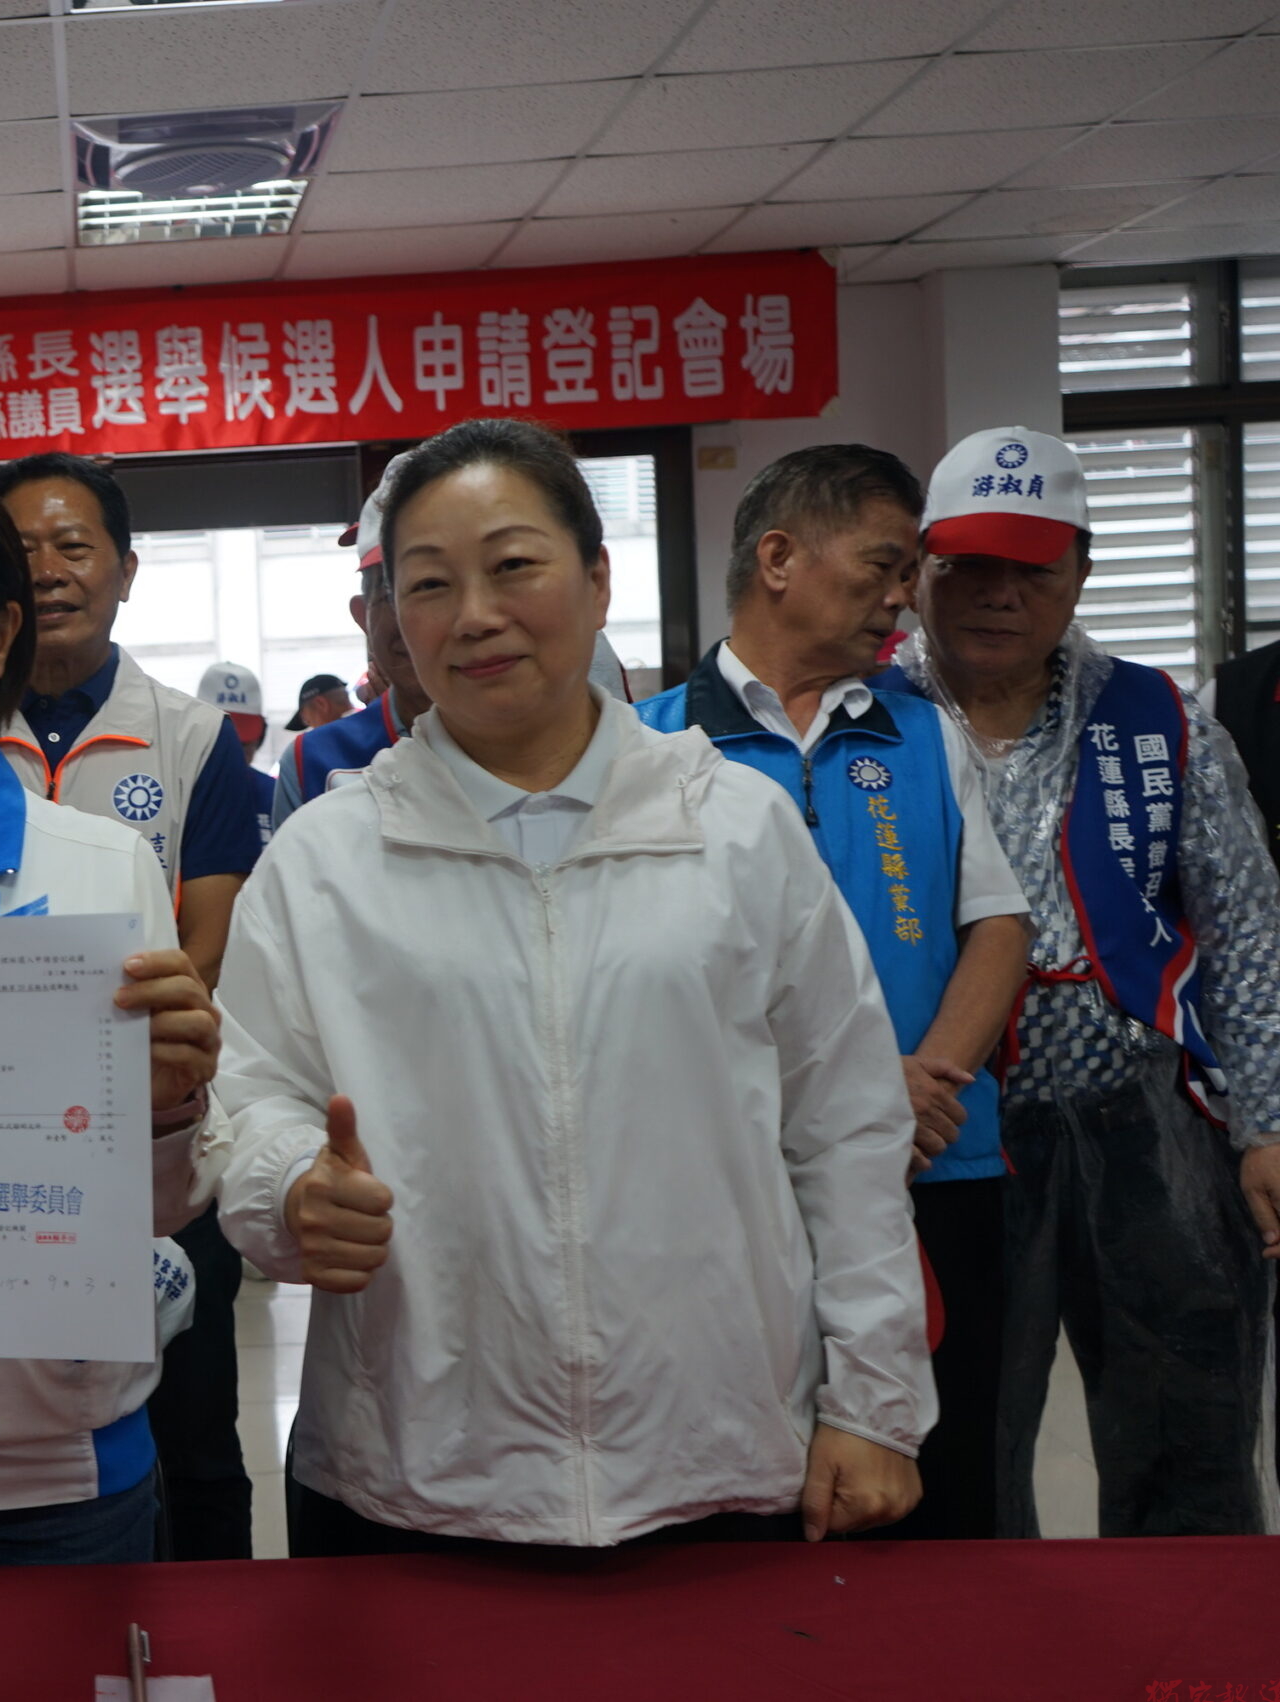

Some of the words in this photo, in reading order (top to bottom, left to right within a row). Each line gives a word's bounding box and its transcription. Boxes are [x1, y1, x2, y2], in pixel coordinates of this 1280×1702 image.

[89, 293, 794, 426] 選舉候選人申請登記會場
